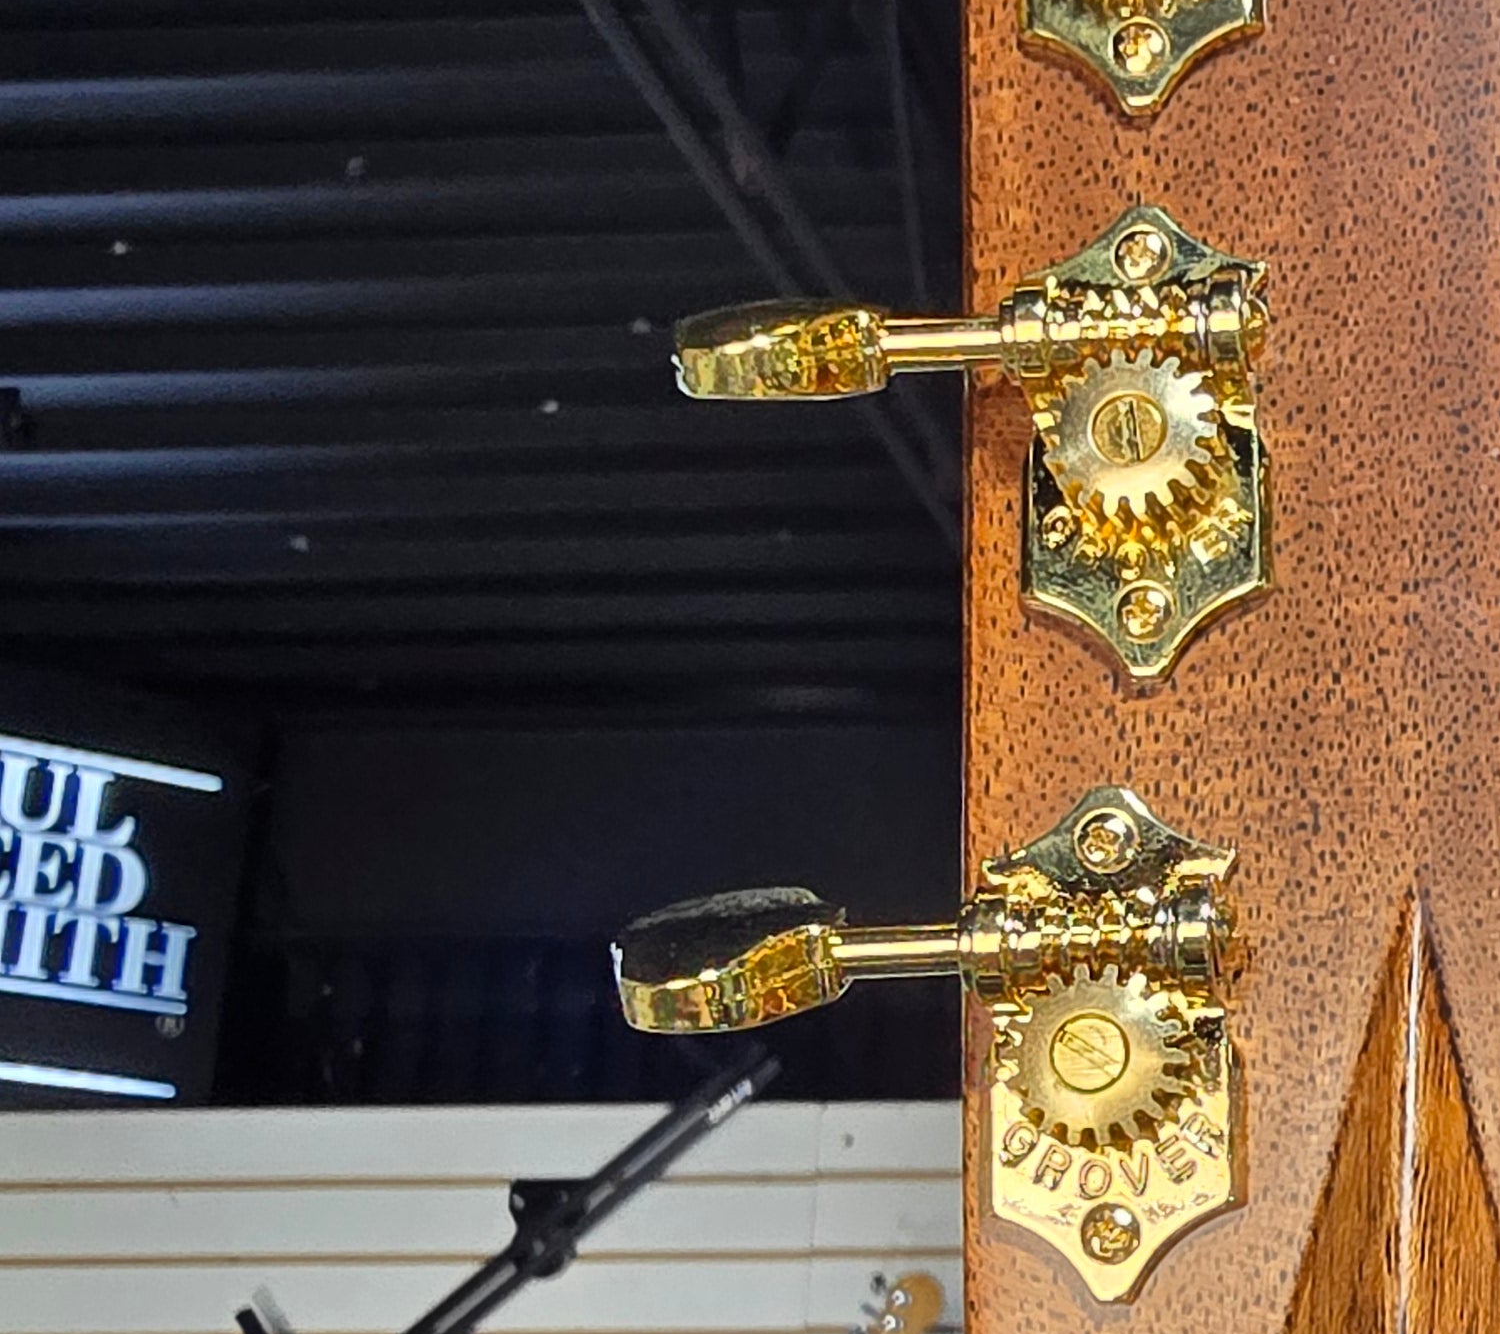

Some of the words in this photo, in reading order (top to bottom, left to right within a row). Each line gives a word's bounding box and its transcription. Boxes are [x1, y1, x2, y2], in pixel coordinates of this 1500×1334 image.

[0, 824, 147, 916] ED
[0, 899, 198, 1003] ITH
[1002, 1112, 1223, 1200] GROVER
